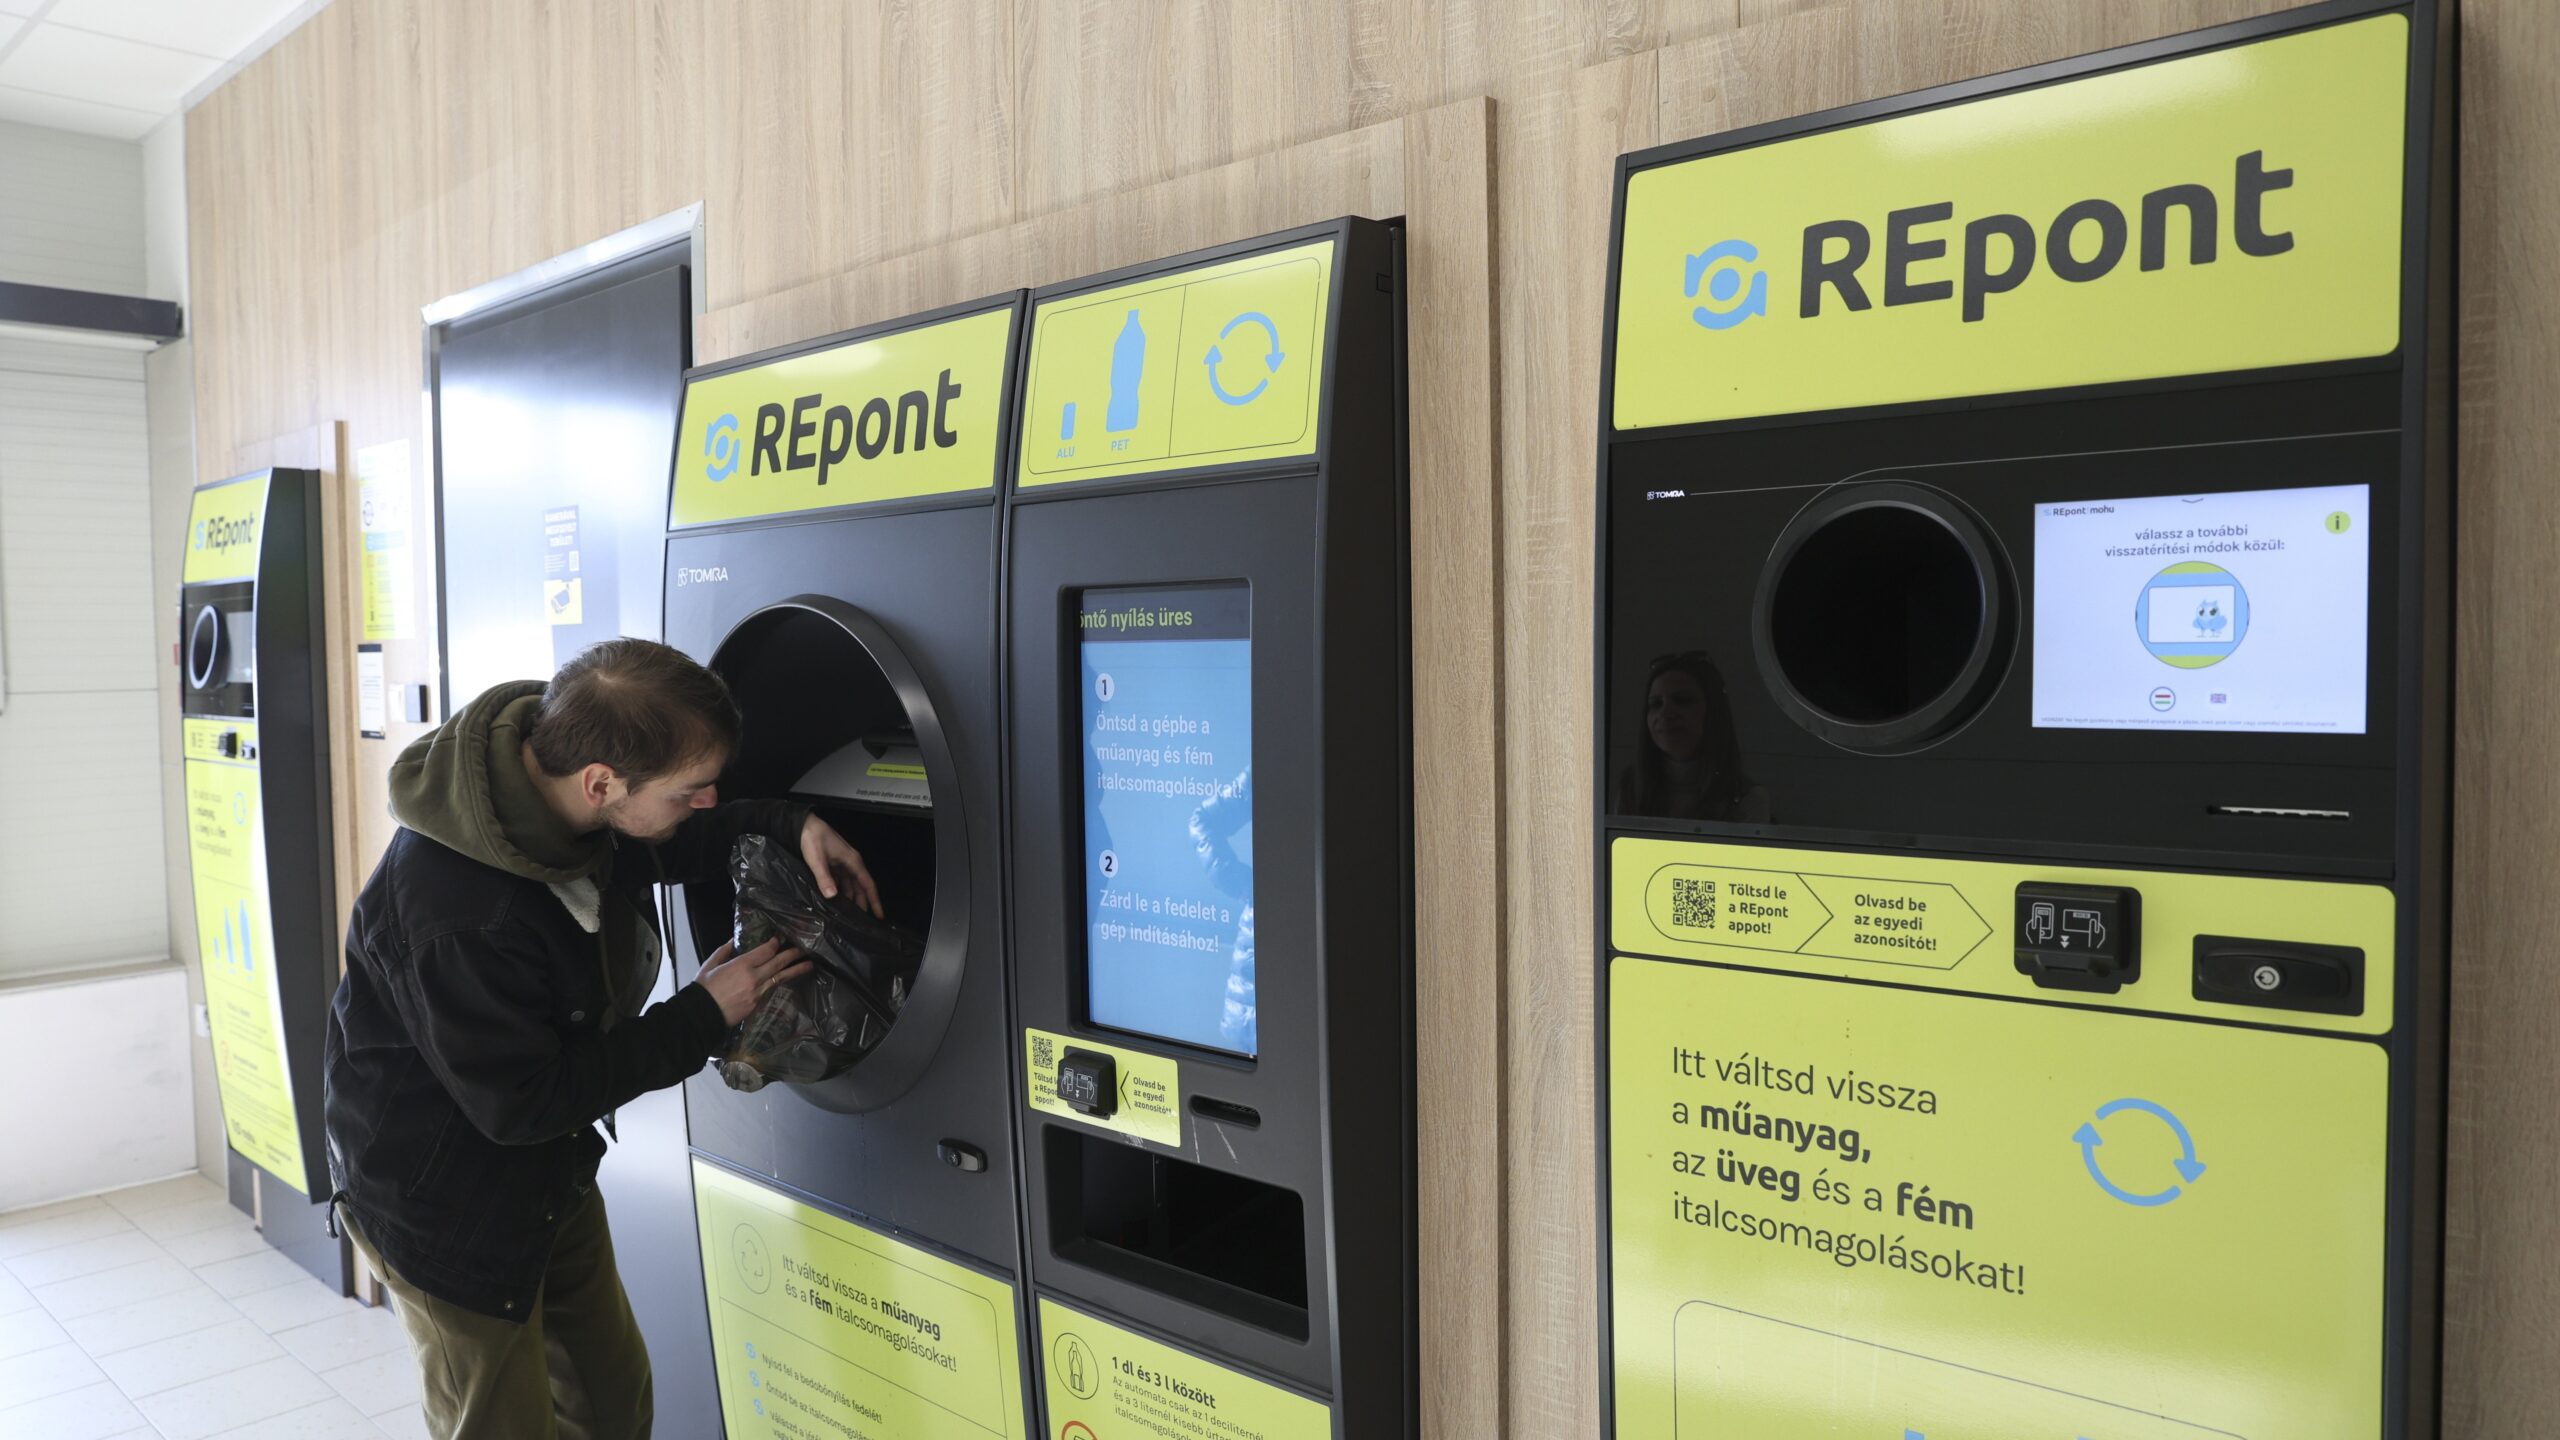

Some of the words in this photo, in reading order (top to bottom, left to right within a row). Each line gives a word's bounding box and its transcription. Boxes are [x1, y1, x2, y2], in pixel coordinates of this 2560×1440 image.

[1799, 149, 2294, 323] REpont
[751, 368, 962, 486] REpont
[1056, 446, 1075, 459] ALU
[1111, 438, 1130, 451] PET
[1655, 490, 1685, 499] TOMRA
[2053, 507, 2086, 517] REpont
[2090, 505, 2115, 515] mohu
[206, 511, 254, 555] REpont
[2135, 529, 2183, 541] válassz
[2186, 529, 2194, 538] a
[2198, 524, 2248, 538] további
[2105, 542, 2190, 557] visszatérítési
[2194, 540, 2240, 553] módok
[2244, 539, 2285, 552] közül:
[689, 567, 728, 583] TOMRA
[1111, 607, 1154, 632] nyílás
[1159, 607, 1193, 626] üres
[1101, 679, 1107, 696] 1
[1096, 711, 1136, 732] Öntsd
[1140, 720, 1148, 732] a
[1153, 714, 1197, 737] gépbe
[1201, 721, 1210, 735] a
[1097, 743, 1160, 767] műanyag
[1163, 745, 1180, 764] és
[1185, 746, 1213, 765] fém
[1097, 773, 1242, 799] italcsomagolásokat!
[1105, 855, 1113, 872] 2
[1729, 883, 1771, 899] Töltsd
[1774, 886, 1787, 900] le
[1100, 887, 1131, 909] Zárd
[1136, 893, 1148, 912] le
[1153, 901, 1160, 913] a
[1165, 896, 1216, 921] fedelet
[1221, 910, 1230, 923] a
[1728, 904, 1736, 914] a
[1740, 904, 1788, 919] REpont
[1854, 894, 1904, 911] Olvasd
[1908, 898, 1926, 912] be
[1728, 921, 1771, 935] appot!
[1854, 915, 1870, 926] az
[1874, 915, 1923, 931] egyedi
[1101, 920, 1126, 942] gép
[1131, 922, 1219, 953] indításához!
[1854, 932, 1937, 951] azonosítót!
[1034, 1072, 1053, 1084] Töltsd
[1133, 1076, 1156, 1091] Olvasd
[1157, 1081, 1166, 1092] be
[1672, 1047, 1706, 1079] Itt
[1715, 1054, 1815, 1096] váltsd
[1827, 1069, 1938, 1116] vissza
[1040, 1085, 1058, 1096] REpo
[1133, 1089, 1142, 1097] az
[1142, 1090, 1165, 1104] egyedi
[1672, 1101, 1689, 1125] a
[1700, 1100, 1872, 1164] műanyag,
[1672, 1149, 1706, 1179] az
[1716, 1147, 1801, 1200] üveg
[1812, 1170, 1851, 1206] és
[1863, 1185, 1883, 1213] a
[1895, 1182, 1974, 1231] fém
[1673, 1191, 2026, 1296] italcsomagolásokat!
[783, 1254, 795, 1274] Itt
[797, 1262, 829, 1289] váltsd
[832, 1278, 867, 1306] vissza
[871, 1297, 878, 1310] a
[881, 1300, 941, 1341] műanyag
[785, 1279, 798, 1298] és
[801, 1290, 807, 1302] a
[810, 1289, 833, 1315] fém
[836, 1302, 957, 1373] italcsomagolásokat!
[1112, 1356, 1118, 1369] 1
[1122, 1359, 1134, 1376] dl
[1137, 1365, 1151, 1382] és
[1154, 1372, 1162, 1387] 3
[1173, 1378, 1216, 1409] között
[1113, 1376, 1122, 1387] Az
[1125, 1382, 1166, 1405] automata
[1169, 1400, 1190, 1414] csak
[1192, 1408, 1202, 1420] az
[1114, 1389, 1124, 1402] és
[1125, 1396, 1131, 1404] a
[1133, 1398, 1139, 1408] 3
[1140, 1401, 1171, 1422] liternél
[1173, 1415, 1204, 1436] kisebb
